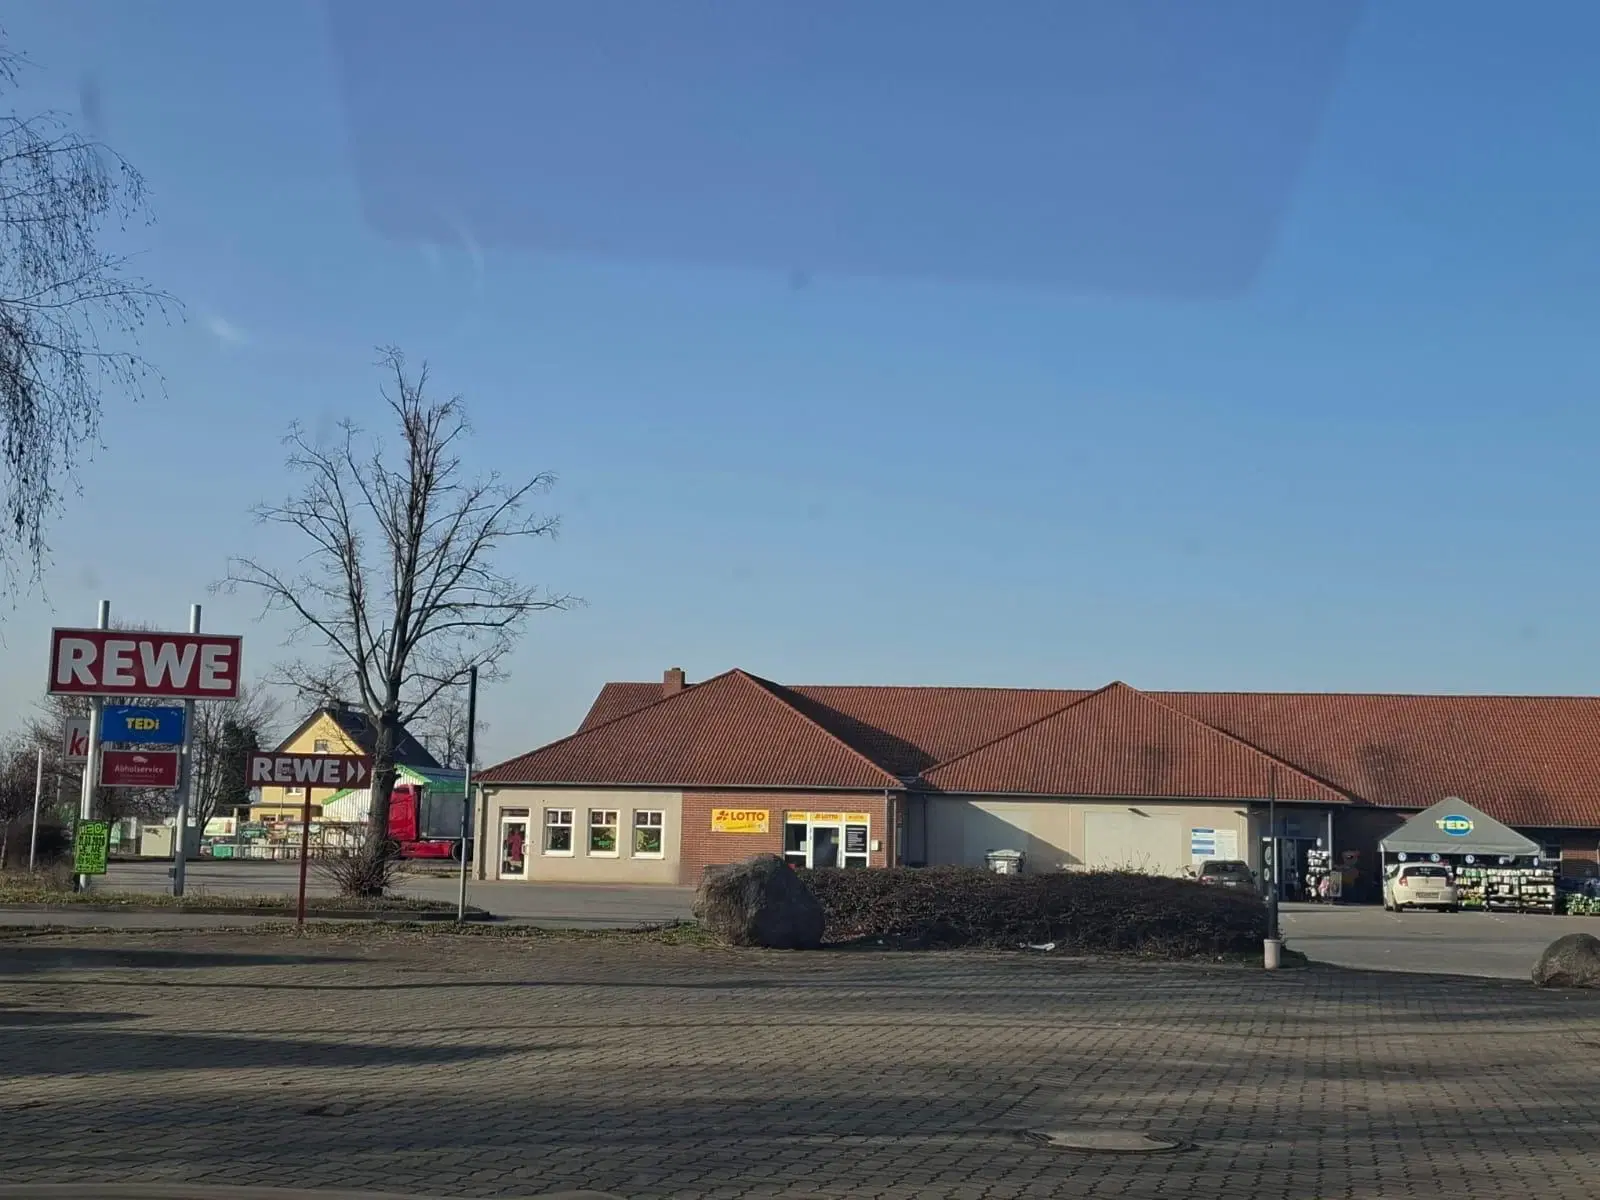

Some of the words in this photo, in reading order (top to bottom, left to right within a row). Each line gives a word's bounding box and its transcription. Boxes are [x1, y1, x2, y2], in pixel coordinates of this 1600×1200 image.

[57, 638, 232, 690] REWE
[126, 717, 160, 730] TEDi
[114, 764, 164, 774] Abholservice
[252, 757, 341, 783] REWE
[730, 811, 765, 821] LOTTO
[1435, 819, 1474, 830] TEDi
